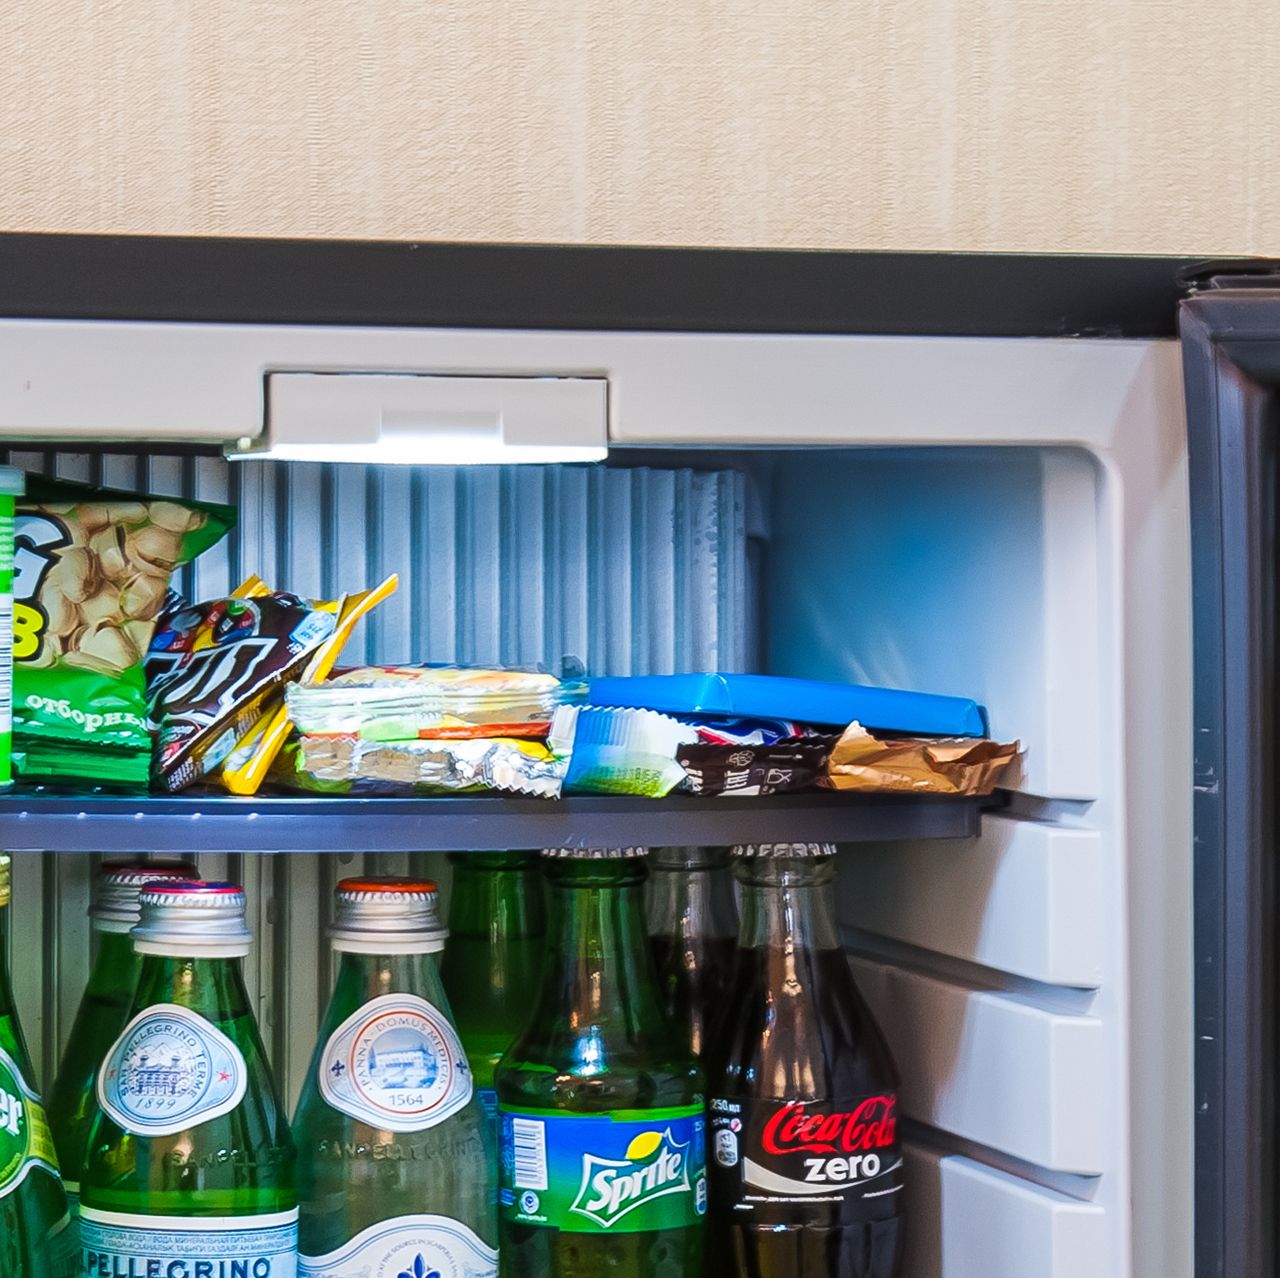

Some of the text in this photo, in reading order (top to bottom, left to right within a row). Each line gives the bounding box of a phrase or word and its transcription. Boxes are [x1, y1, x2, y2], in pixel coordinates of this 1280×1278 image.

[24, 694, 148, 733] отборны
[357, 1038, 372, 1087] PANNA
[375, 1017, 426, 1032] DOMUS
[135, 1098, 176, 1110] 1899
[389, 1094, 424, 1106] 1564
[763, 1094, 897, 1155] Coca-Cola
[588, 1150, 683, 1214] Sprite
[804, 1153, 880, 1182] zero
